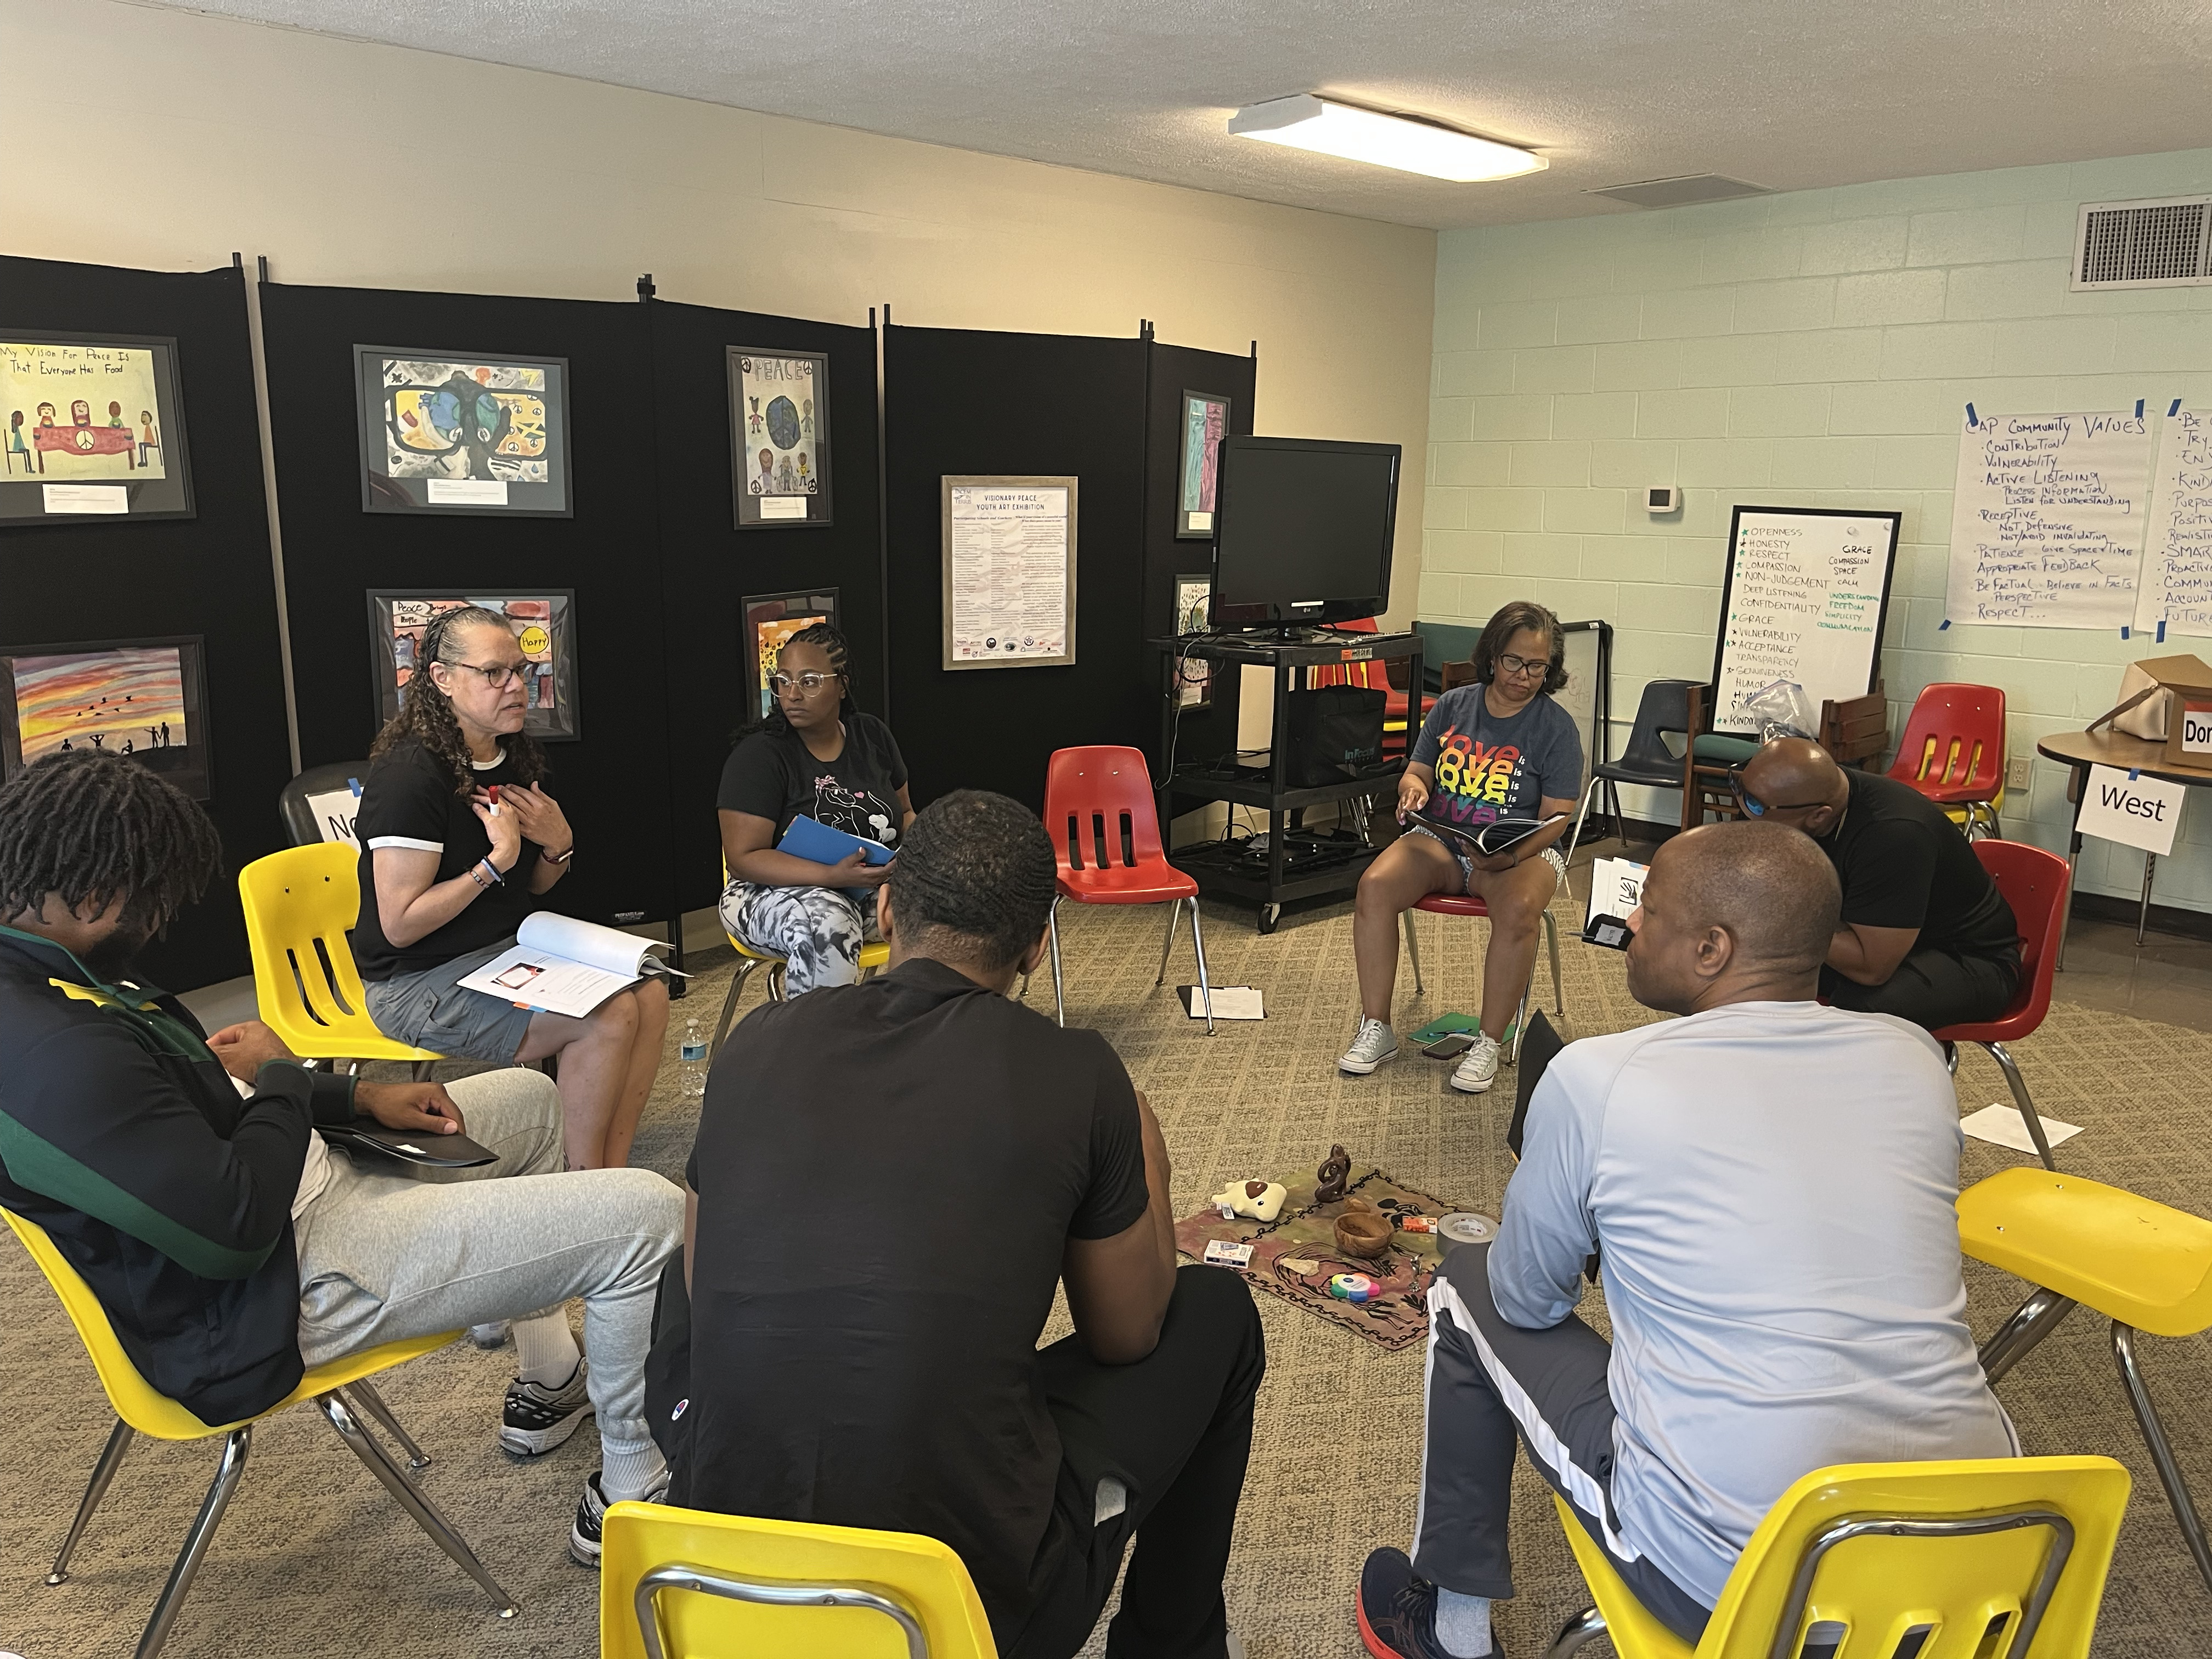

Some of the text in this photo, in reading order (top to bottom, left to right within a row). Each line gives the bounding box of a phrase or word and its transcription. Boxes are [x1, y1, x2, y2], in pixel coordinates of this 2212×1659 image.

[0, 347, 129, 362] My Vision For Peace Is
[10, 360, 123, 376] That Everyone Has Food
[754, 358, 803, 381] PEACE
[1965, 417, 1999, 435] CAP
[2008, 416, 2071, 445] COMMUNITY
[2005, 495, 2034, 505] LISTEN
[1751, 528, 1803, 537] OPENNESS
[1999, 522, 2022, 532] NOT
[2168, 528, 2212, 545] REALISTI
[1750, 539, 1790, 550] HONESTY
[1842, 545, 1872, 554] GRACE
[1749, 549, 1790, 561] RESPECT
[1976, 544, 2024, 559] PATIENCE
[1745, 561, 1801, 573] COMPASSION
[1829, 556, 1870, 566] COMPASSION
[2041, 555, 2103, 574] FEEDBACK
[1833, 567, 1858, 575] SPACE
[1745, 571, 1831, 590] NON-JUDGEMENT
[1837, 579, 1859, 587] CALM
[1743, 584, 1807, 599] DEEP LISTENING
[398, 601, 423, 613] Peace
[1740, 597, 1821, 615] CONFIDENTIALITY
[1829, 601, 1864, 611] FREEDOM
[1739, 613, 1775, 624] GRACE
[1825, 611, 1862, 622] SIMPLICITY
[1817, 622, 1873, 633] COMMUNICATION
[1739, 627, 1802, 643] VULNERABILITY
[1739, 640, 1796, 653] ACCEPTANCE
[1736, 653, 1799, 668] TRANSPARENCY
[1736, 666, 1795, 679] GENUINENESS
[1736, 678, 1766, 689] HUMOR
[1519, 755, 1526, 765] is
[1514, 768, 1522, 776] is
[1511, 781, 1519, 790] is
[1508, 794, 1517, 803] is
[2102, 784, 2166, 822] West
